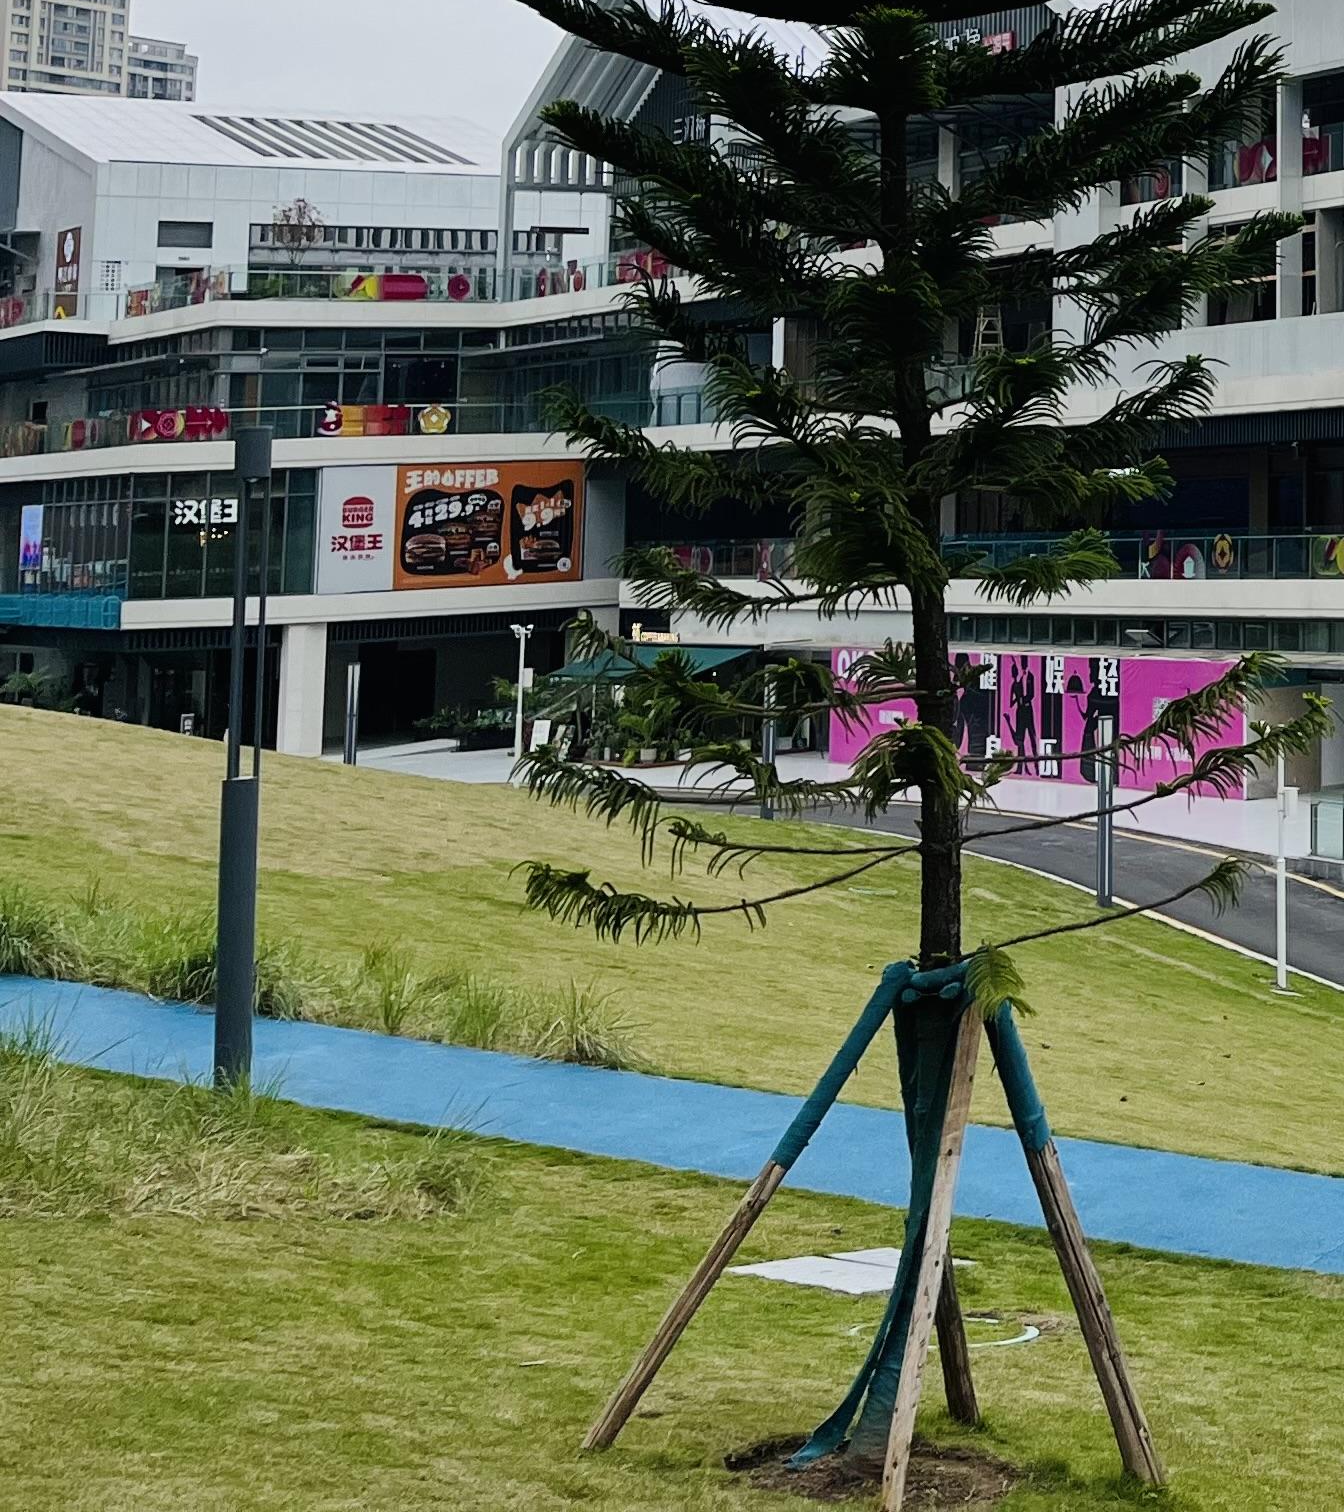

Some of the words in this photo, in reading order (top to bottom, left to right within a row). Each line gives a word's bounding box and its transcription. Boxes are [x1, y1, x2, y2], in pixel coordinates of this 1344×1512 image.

[343, 514, 373, 522] KING
[331, 534, 384, 553] 汉堡王
